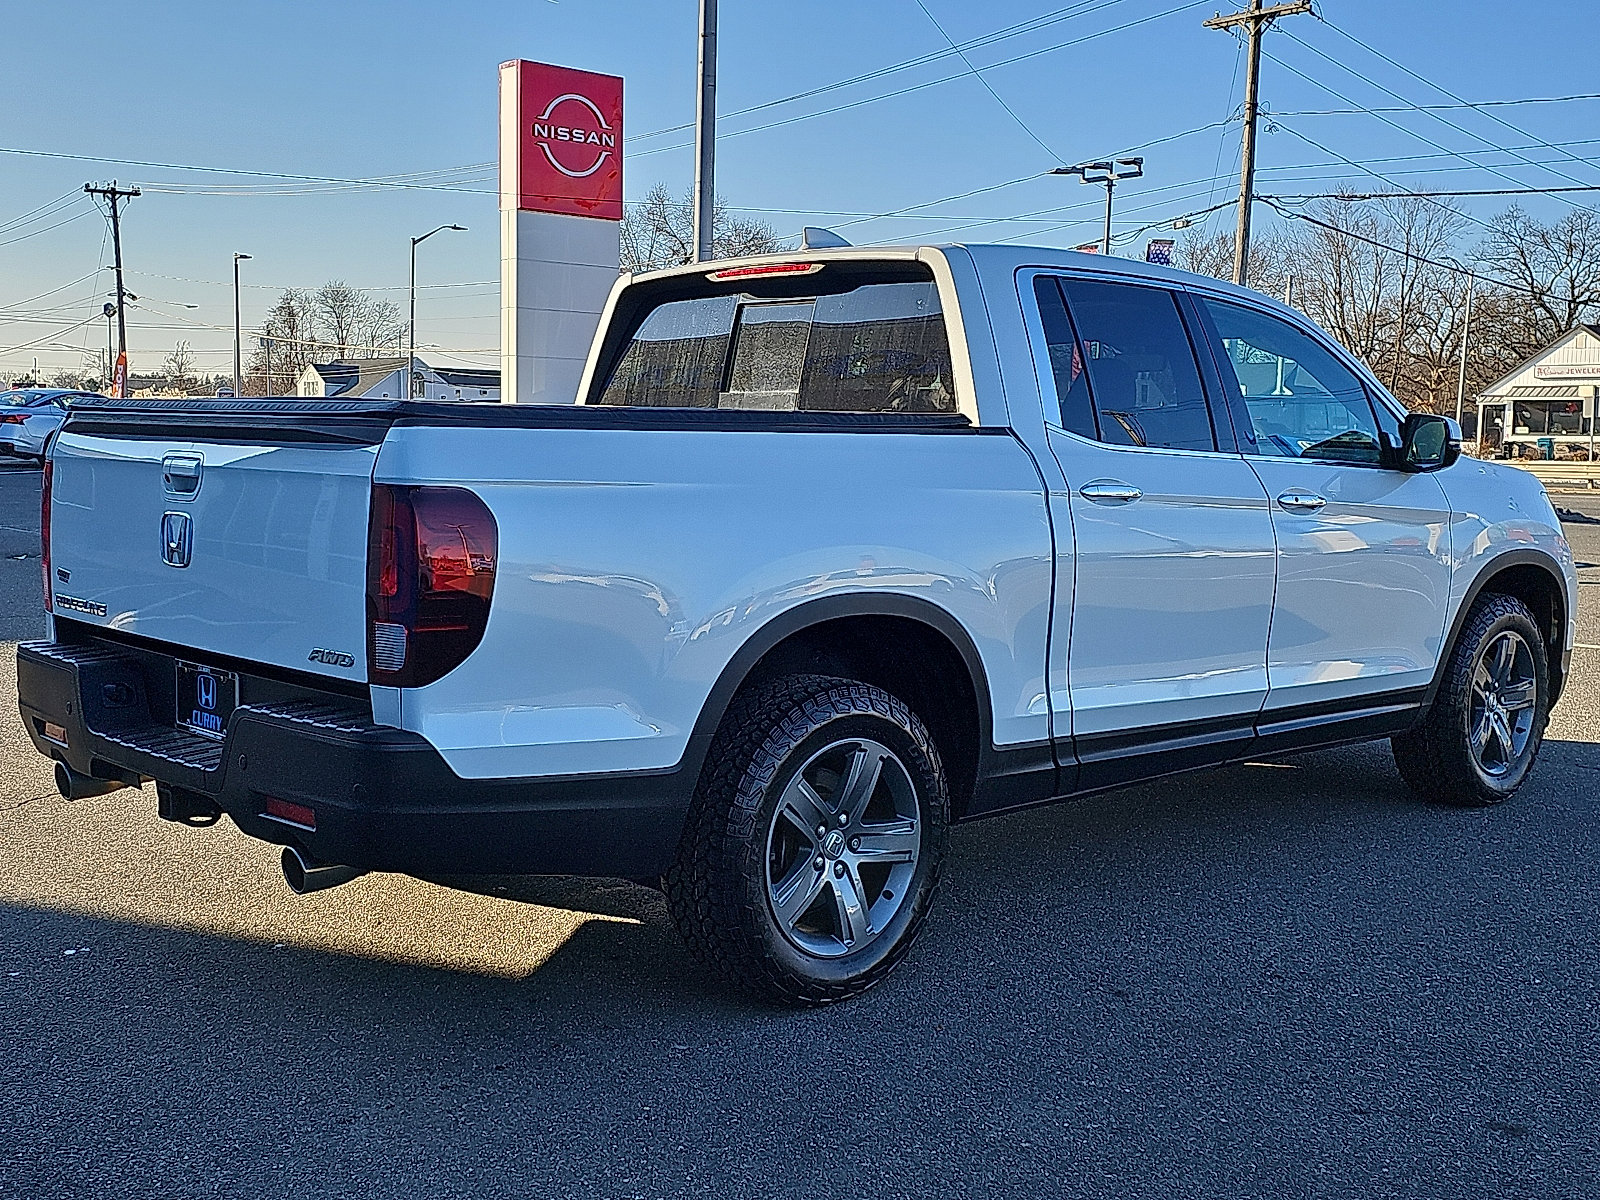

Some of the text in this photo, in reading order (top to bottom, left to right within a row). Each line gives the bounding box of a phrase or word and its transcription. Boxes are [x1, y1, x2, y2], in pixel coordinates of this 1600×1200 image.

[533, 123, 616, 148] NISSAN
[308, 646, 355, 668] AWD
[192, 709, 223, 732] CURRY
